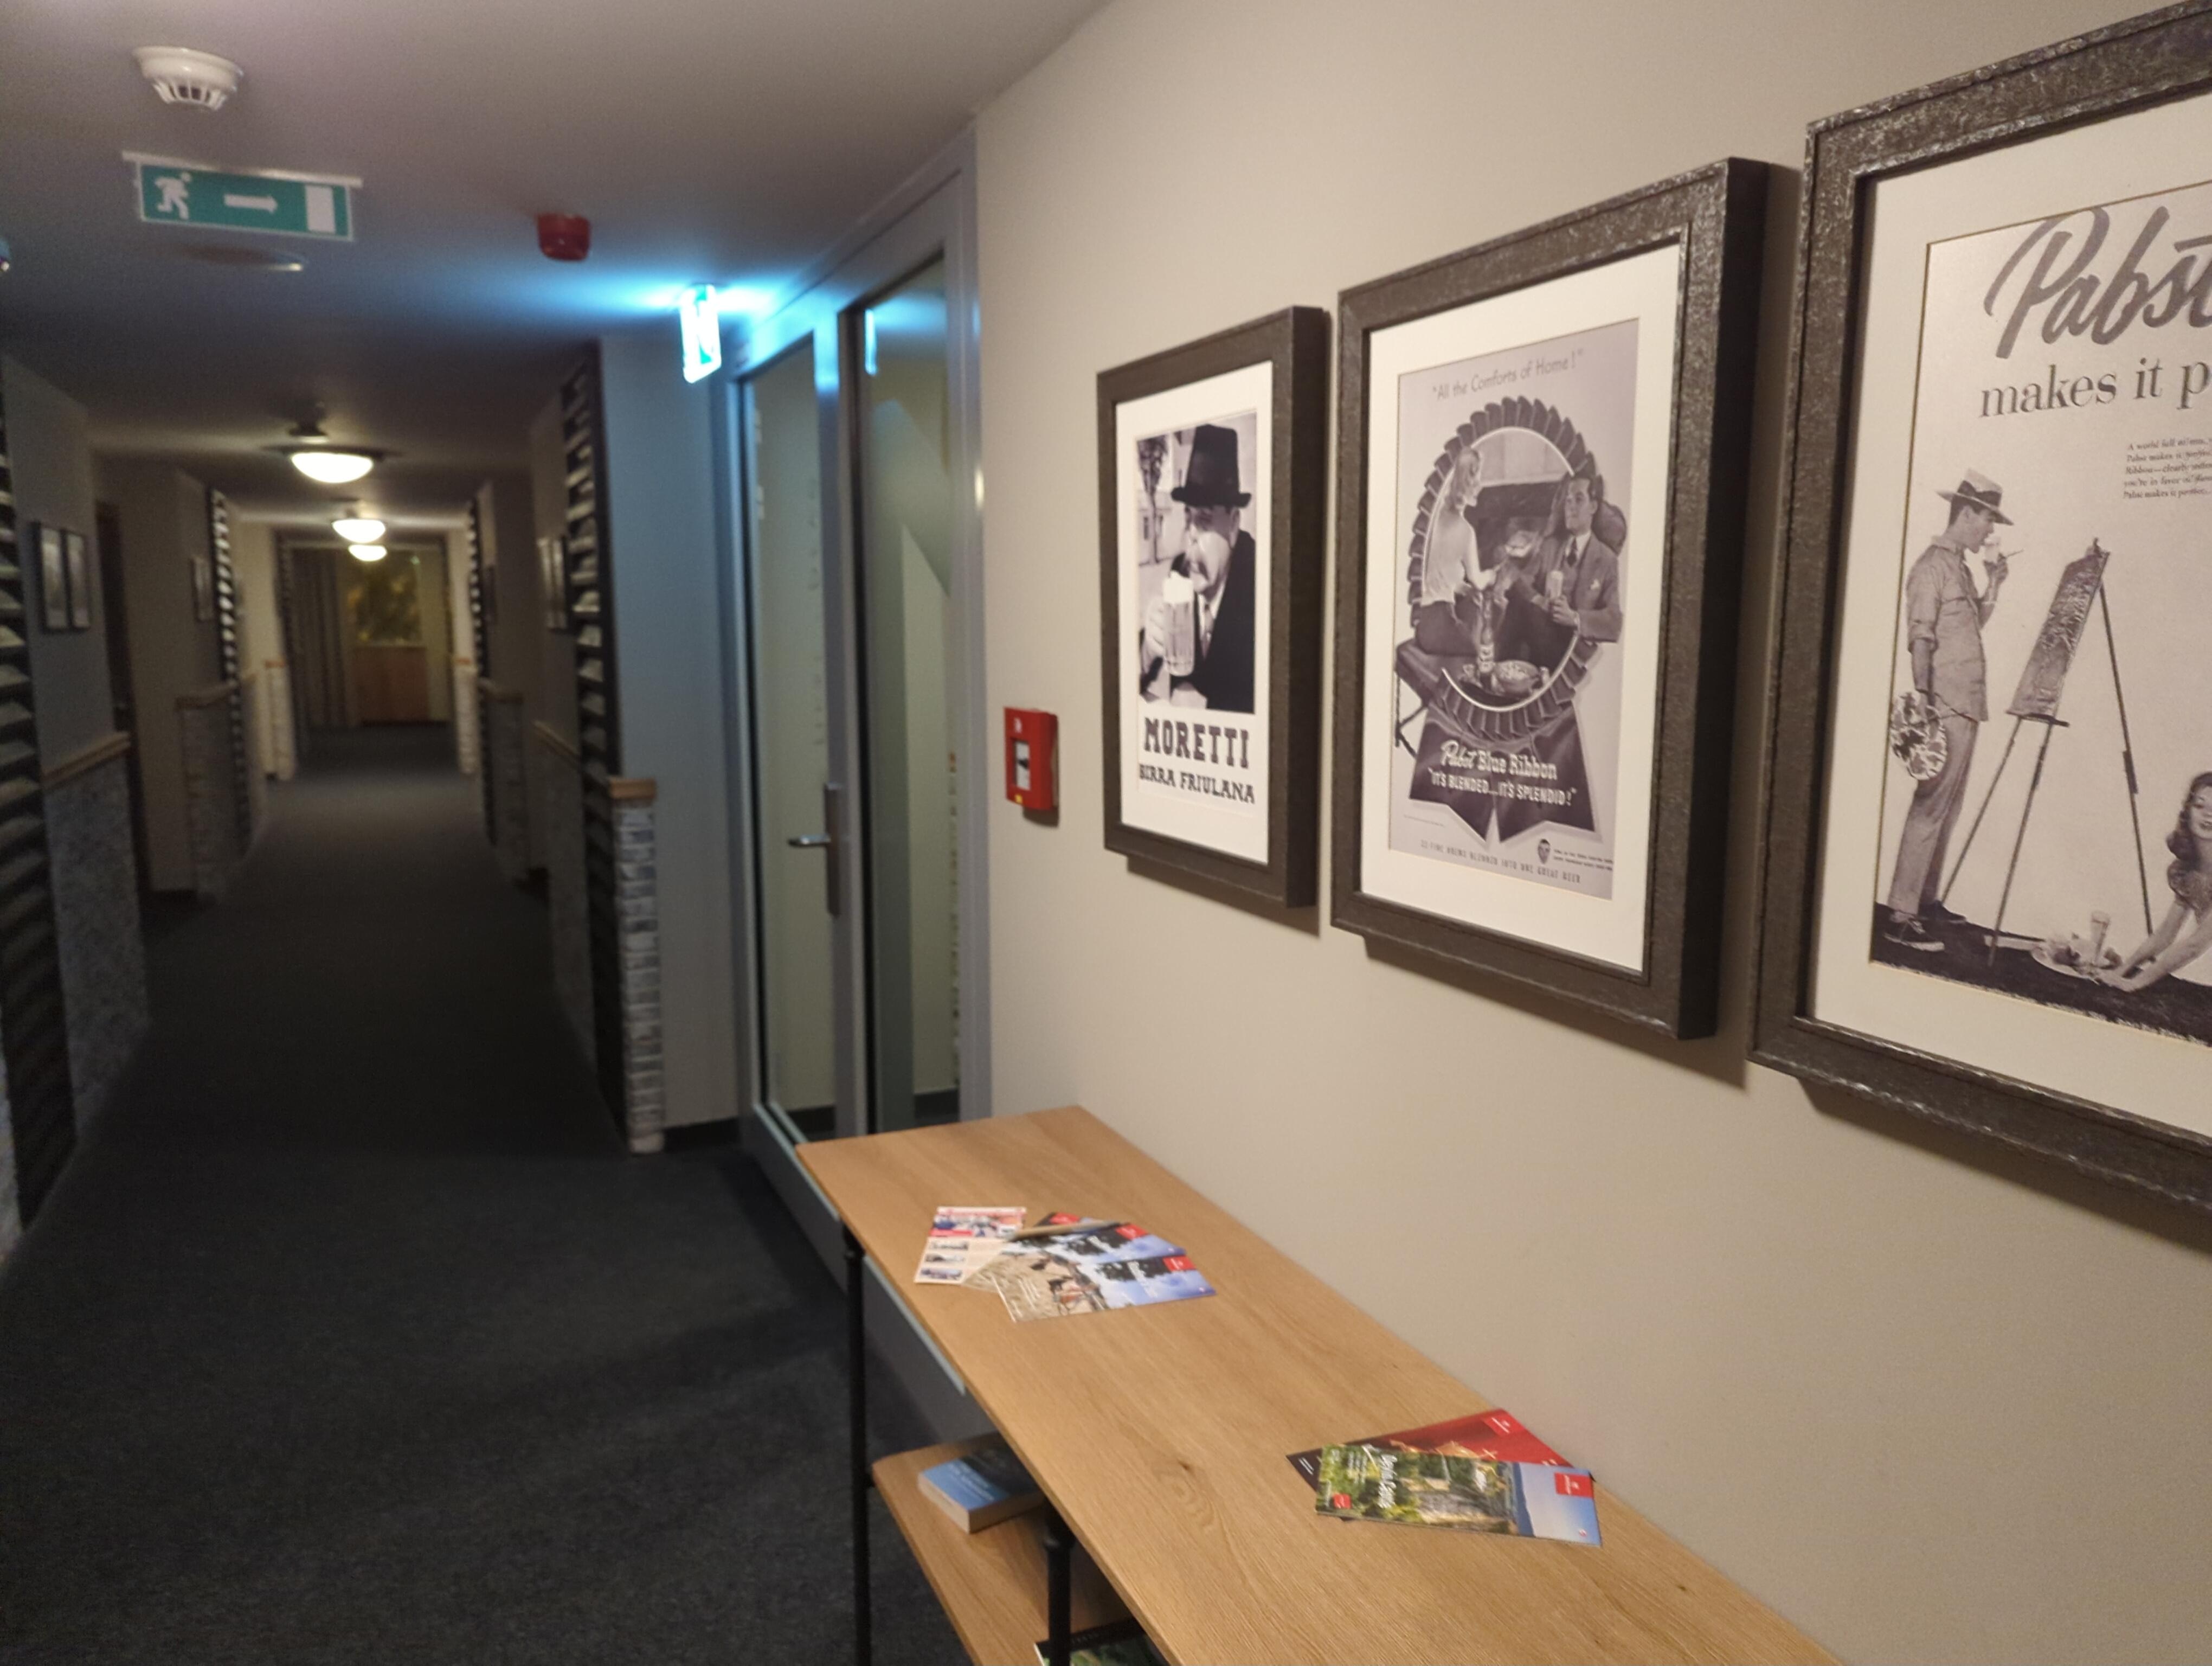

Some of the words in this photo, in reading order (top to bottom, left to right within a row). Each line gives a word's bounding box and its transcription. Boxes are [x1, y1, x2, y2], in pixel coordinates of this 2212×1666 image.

[1453, 381, 1468, 396] the
[1471, 369, 1517, 392] Comforts
[1520, 361, 1532, 379] of
[1536, 357, 1568, 375] Home
[1978, 363, 2118, 418] makes
[2134, 357, 2163, 400] it
[1143, 716, 1249, 770] MORETTI
[1441, 740, 1477, 769] Pabst
[1477, 750, 1507, 774] Blue
[1508, 753, 1558, 780] Ribbon
[1139, 763, 1176, 787] BIRRA
[1180, 771, 1255, 804] FRIULANA
